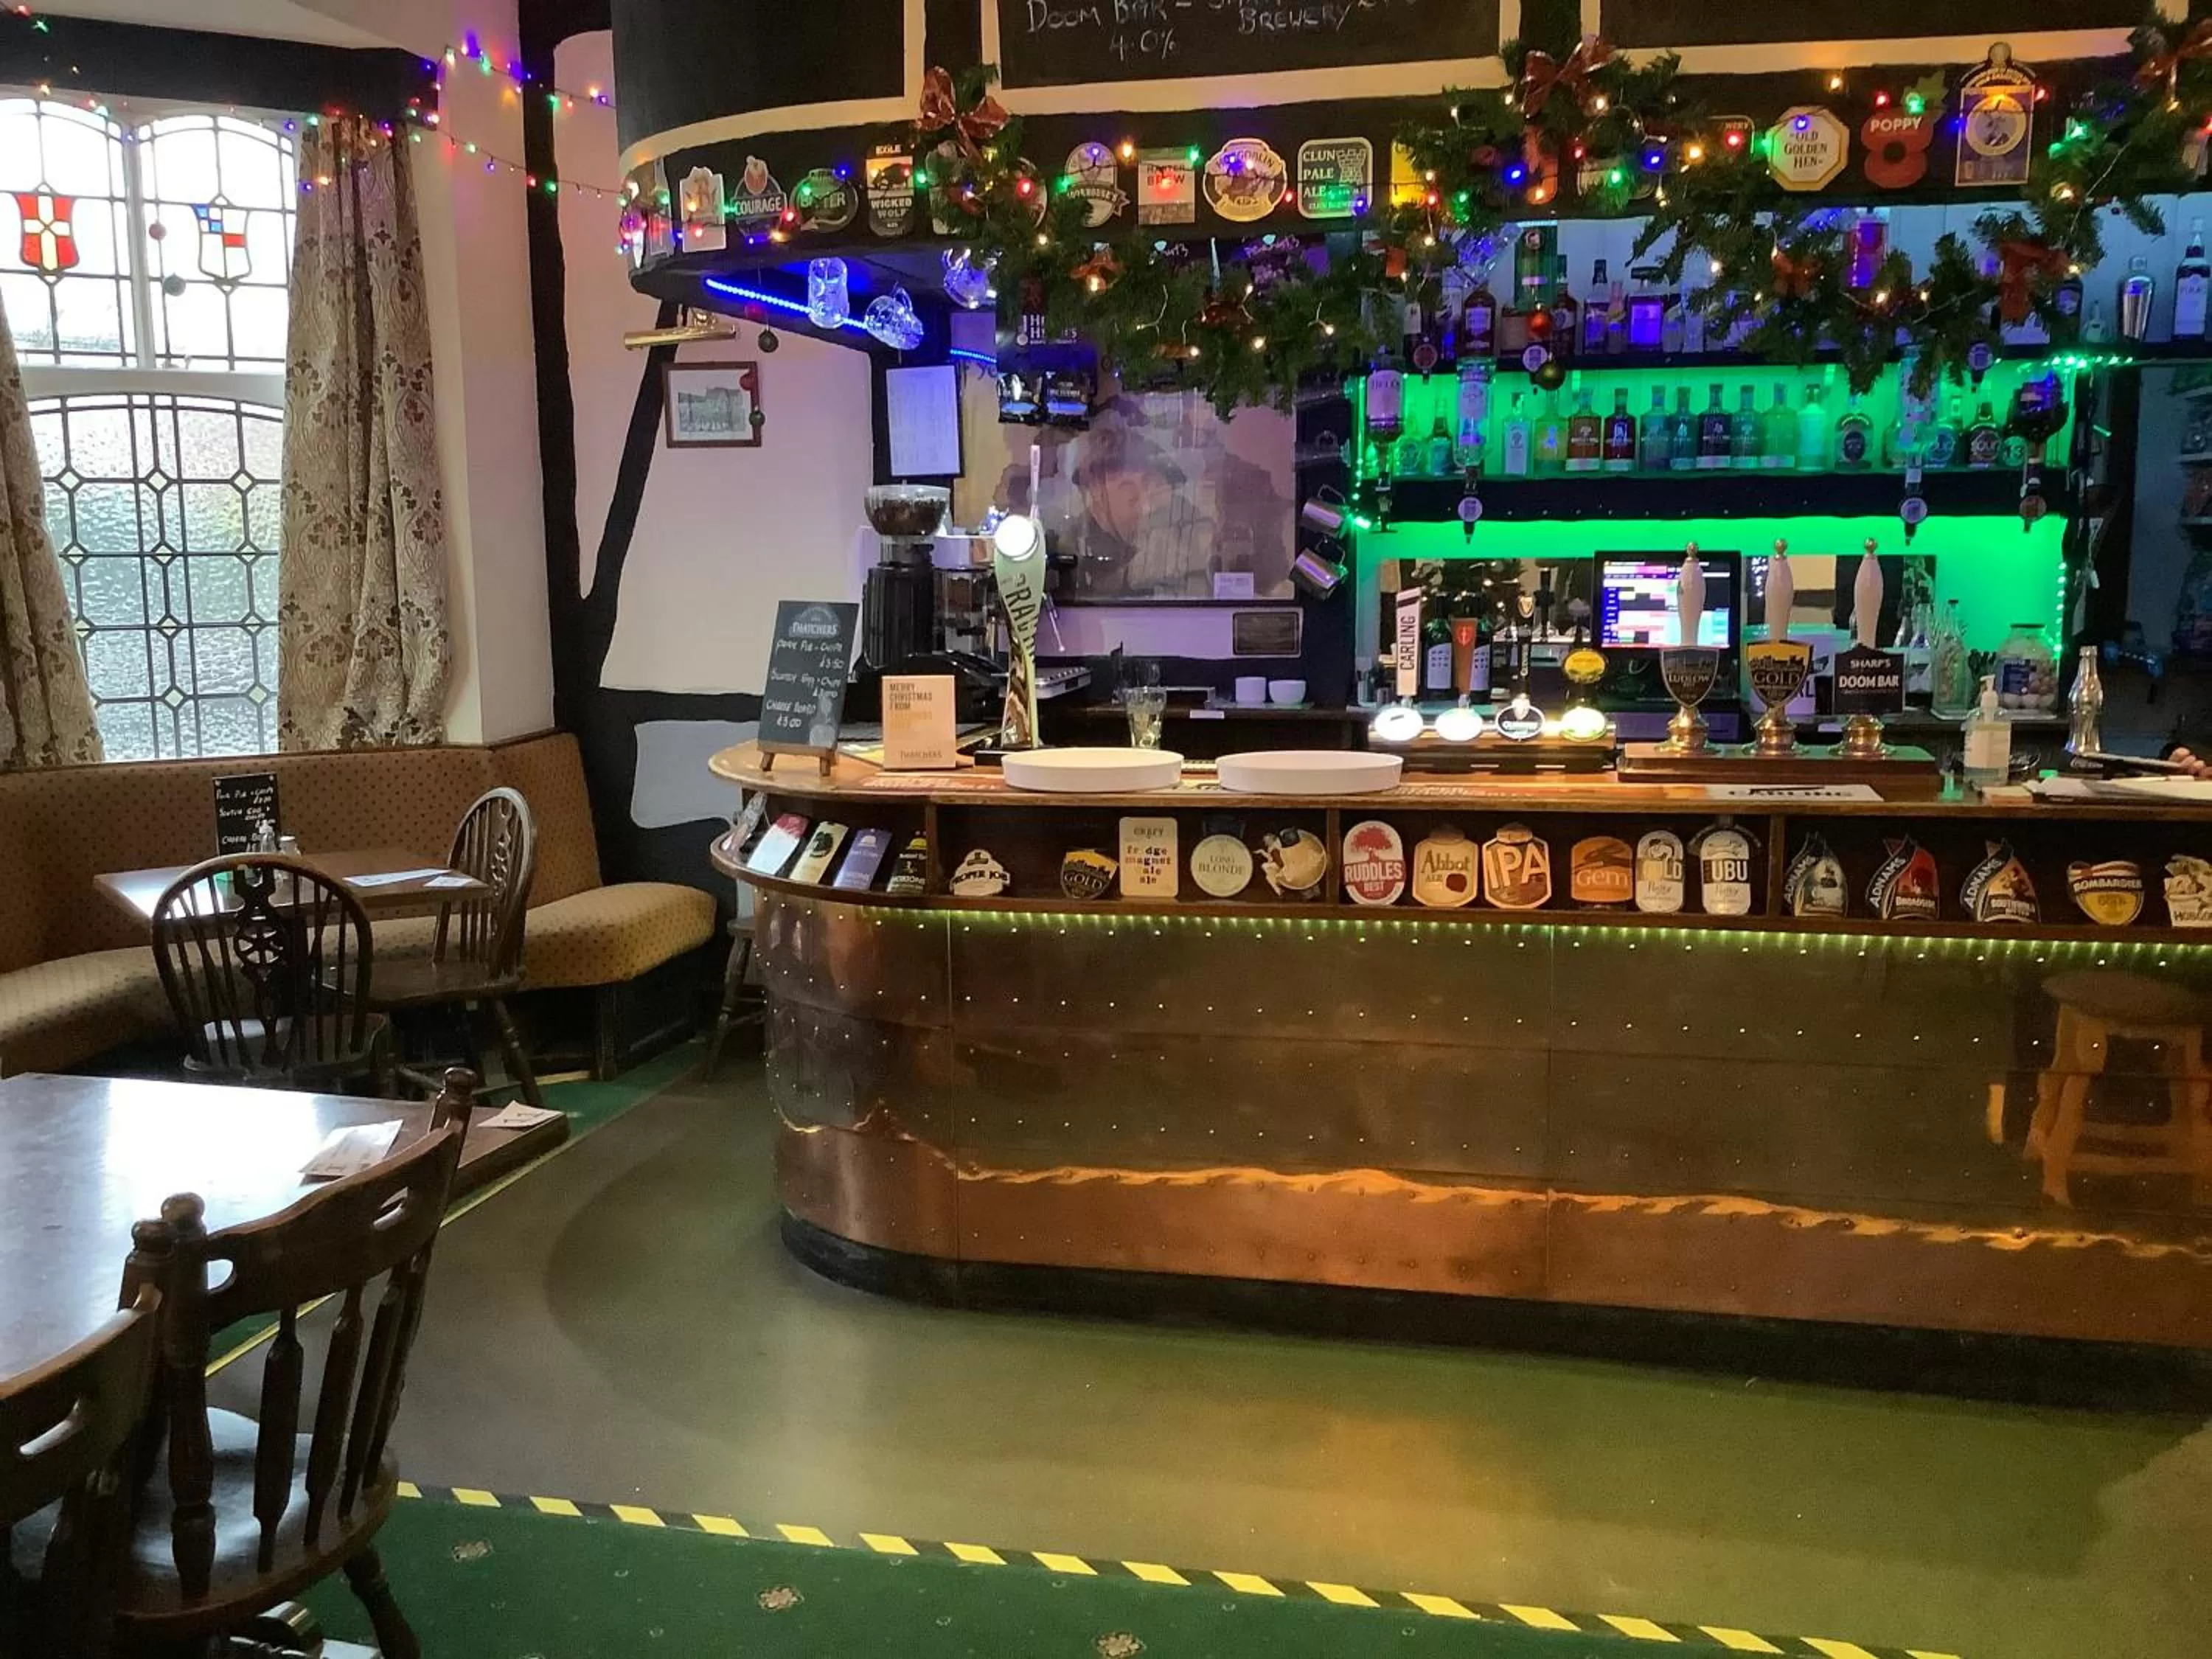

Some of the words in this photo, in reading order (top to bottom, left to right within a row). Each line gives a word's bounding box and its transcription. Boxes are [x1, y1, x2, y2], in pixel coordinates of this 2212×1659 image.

[1871, 116, 1923, 133] POPPY
[1303, 149, 1335, 161] CLUN
[1784, 144, 1828, 155] GOLDEN
[1303, 167, 1335, 180] PALE
[800, 192, 846, 209] BITER
[1303, 186, 1326, 198] ALE
[735, 195, 782, 216] COURAGE
[871, 198, 912, 209] WICKED
[1399, 616, 1416, 670] CARLING
[1669, 672, 1711, 684] LUDLOW
[1754, 672, 1800, 685] GOLD
[1838, 675, 1877, 688] DOOM
[1877, 675, 1899, 688] BAR
[1198, 861, 1243, 875] BLONDE
[1421, 849, 1470, 874] Abbot
[1485, 842, 1547, 889] IPA
[1344, 862, 1402, 883] RUDDLES
[1576, 869, 1629, 889] Gem
[1711, 860, 1748, 881] UBU
[1064, 872, 1103, 889] GOLD
[1783, 855, 1817, 905] ADNAMS
[1869, 857, 1907, 908] ADNAMS
[1964, 858, 2003, 909] ADNAMS
